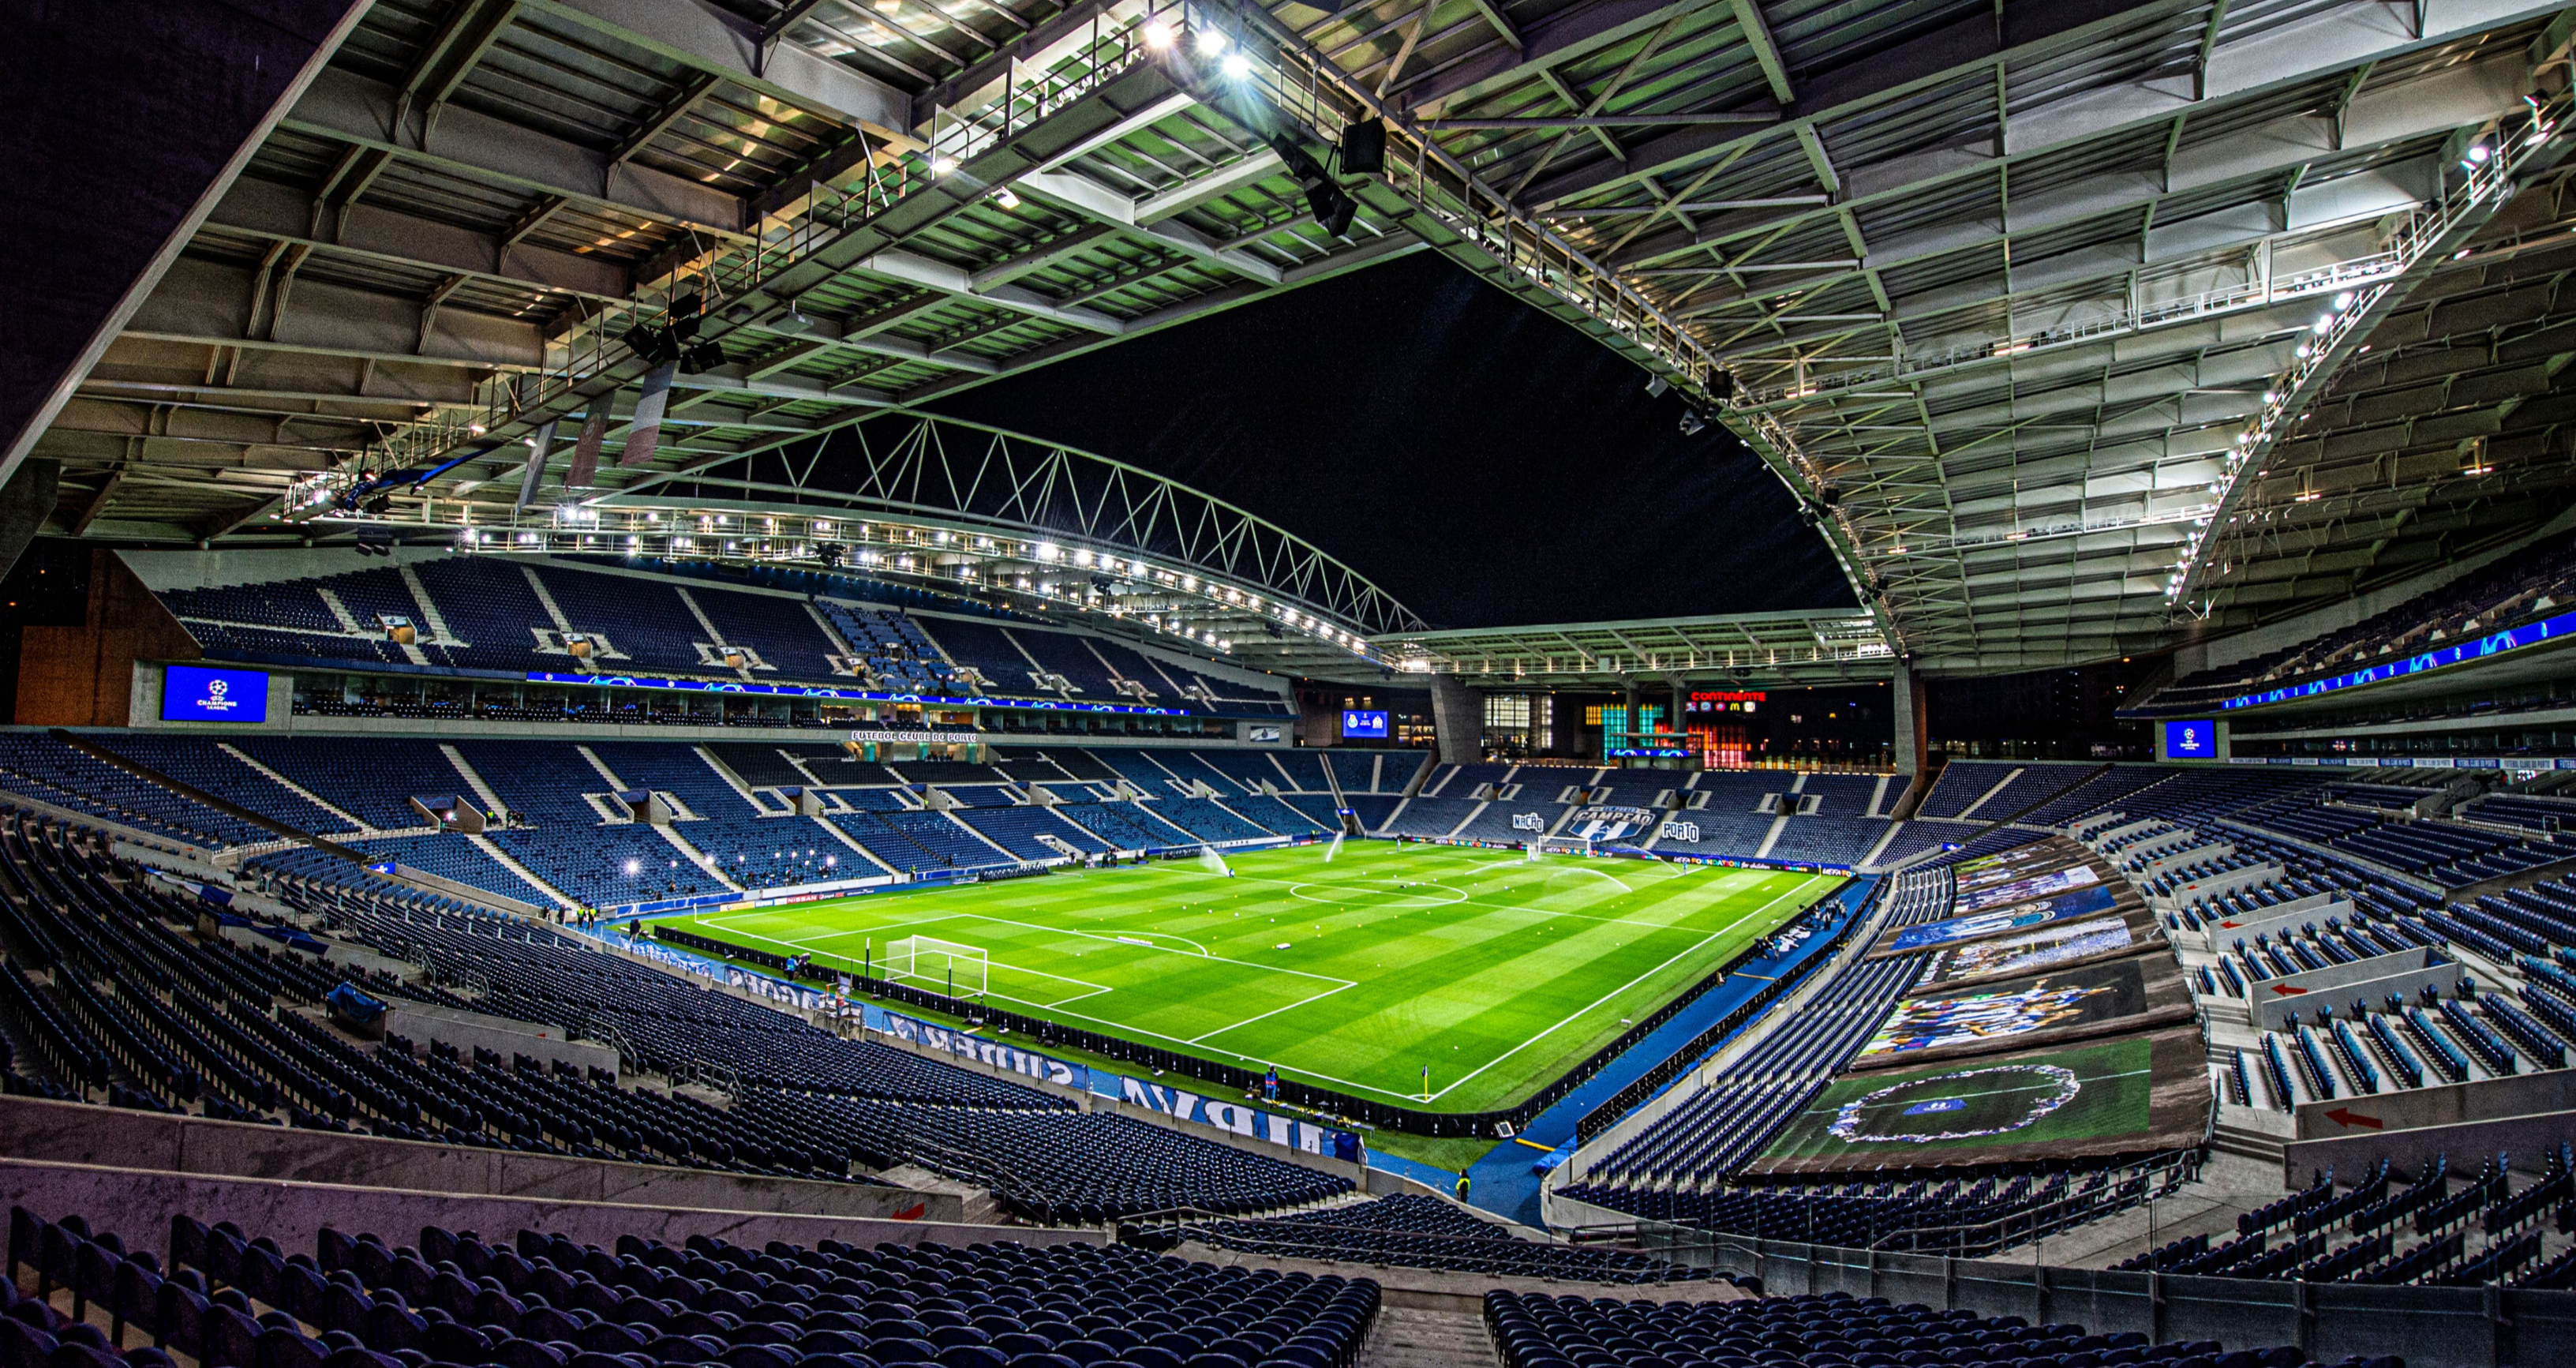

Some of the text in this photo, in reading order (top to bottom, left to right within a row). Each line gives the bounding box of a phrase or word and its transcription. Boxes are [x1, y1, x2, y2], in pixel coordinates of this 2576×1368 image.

[852, 731, 978, 743] FUTEBOL CLUBE DO PORTO
[1663, 823, 1698, 841] PORTO
[1691, 858, 1740, 868] FOUNDATION
